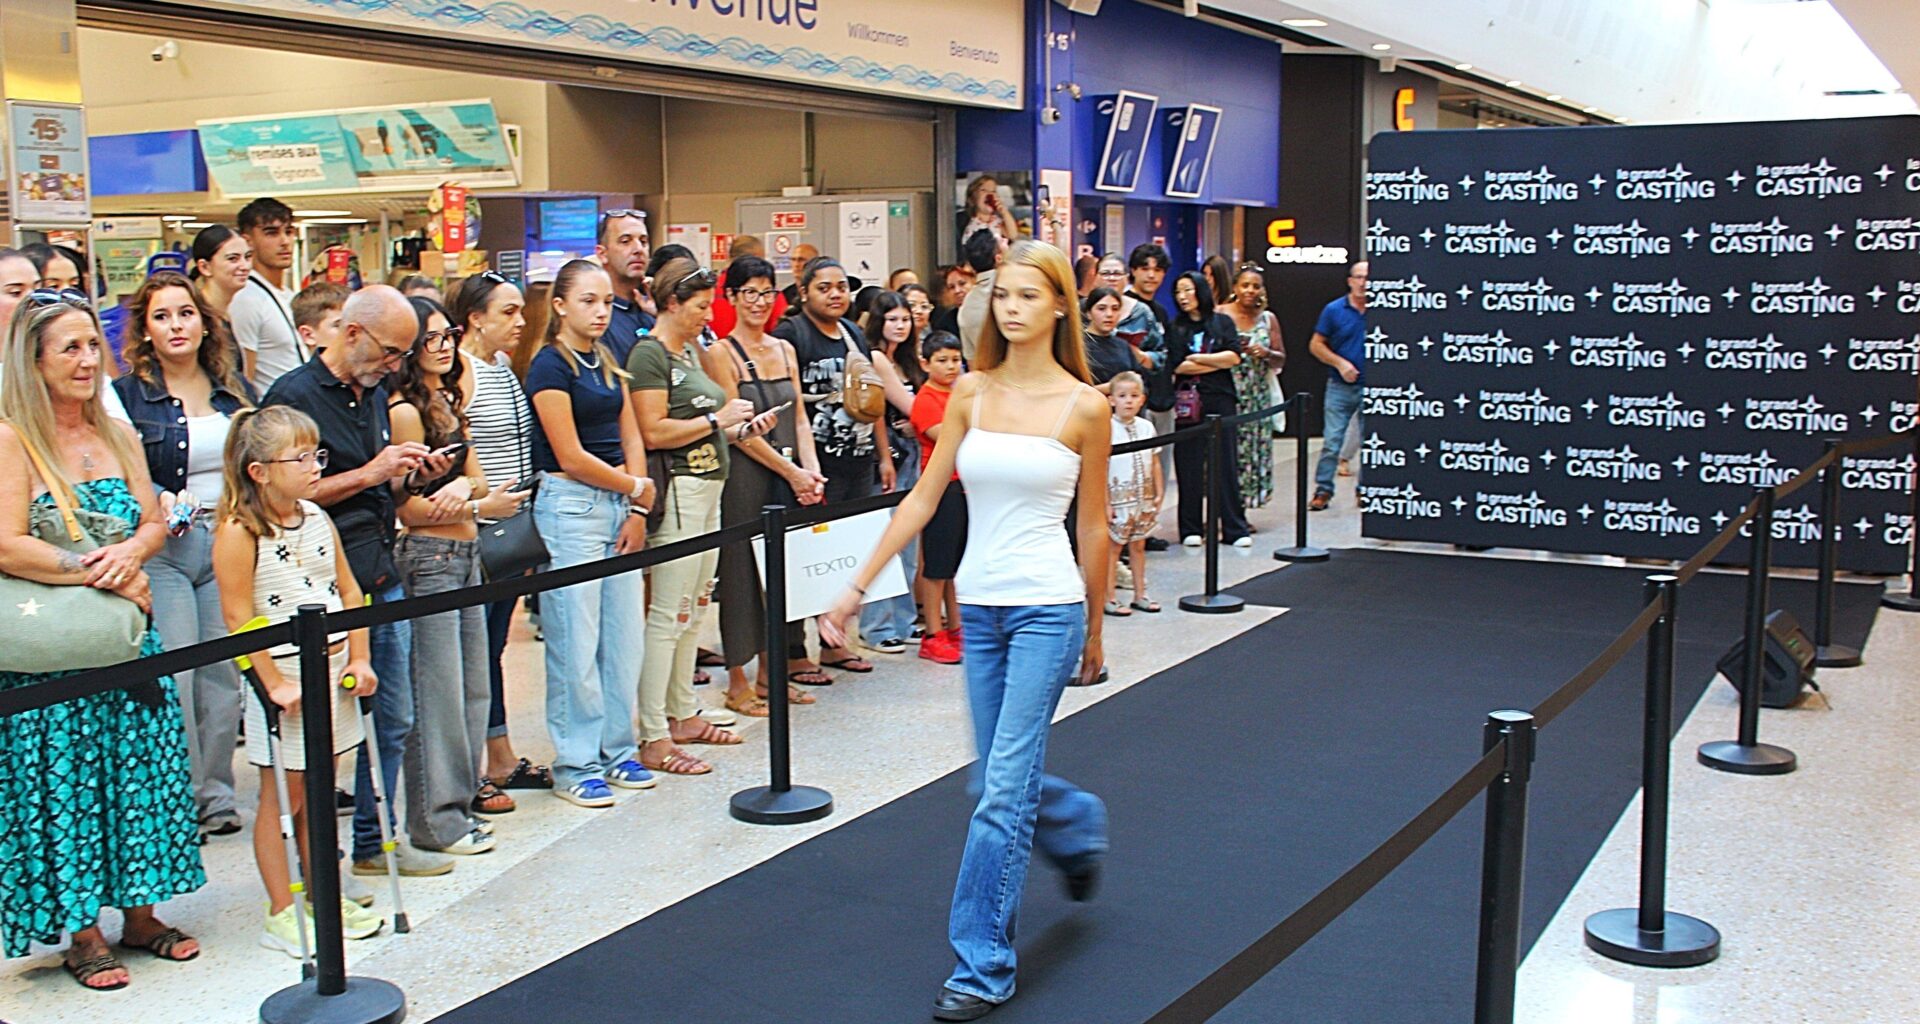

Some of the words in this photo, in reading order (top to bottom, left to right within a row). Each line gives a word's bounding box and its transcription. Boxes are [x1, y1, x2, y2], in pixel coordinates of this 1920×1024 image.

[848, 21, 910, 47] Willkommen
[950, 40, 999, 64] Benvenuto
[1374, 171, 1405, 183] grand
[1500, 171, 1532, 183] grand
[1630, 168, 1666, 182] grand
[1770, 163, 1810, 178] grand
[1485, 182, 1578, 204] CASTING
[1616, 180, 1715, 202] CASTING
[1756, 174, 1861, 198] CASTING
[1459, 224, 1491, 236] grand
[1589, 224, 1623, 238] grand
[1725, 222, 1762, 236] grand
[1871, 218, 1911, 233] grand
[1445, 236, 1536, 257] CASTING
[1574, 236, 1670, 258] CASTING
[1710, 234, 1813, 256] CASTING
[1372, 279, 1404, 291] grand
[1497, 282, 1529, 295] grand
[1627, 283, 1662, 296] grand
[1766, 282, 1804, 295] grand
[1483, 294, 1574, 315] CASTING
[1613, 294, 1710, 317] CASTING
[1751, 294, 1854, 317] CASTING
[1457, 334, 1489, 345] grand
[1585, 337, 1620, 349] grand
[1720, 338, 1757, 351] grand
[1864, 339, 1903, 352] grand
[1443, 344, 1533, 367] CASTING
[1571, 349, 1666, 371] CASTING
[1706, 351, 1806, 373] CASTING
[1370, 387, 1401, 398] grand
[1495, 392, 1525, 403] grand
[1622, 396, 1658, 408] grand
[1760, 399, 1798, 414] grand
[1480, 402, 1571, 425] CASTING
[1609, 408, 1705, 430] CASTING
[1746, 412, 1847, 435] CASTING
[1455, 442, 1486, 455] grand
[1582, 449, 1614, 460] grand
[1440, 452, 1529, 475] CASTING
[1715, 454, 1751, 466] grand
[1857, 459, 1896, 470] grand
[1567, 461, 1660, 482] CASTING
[1367, 487, 1398, 499] grand
[1491, 495, 1522, 505] grand
[1618, 502, 1653, 513] grand
[1476, 504, 1566, 528] CASTING
[1604, 512, 1699, 536] CASTING
[802, 556, 857, 578] TEXTO
